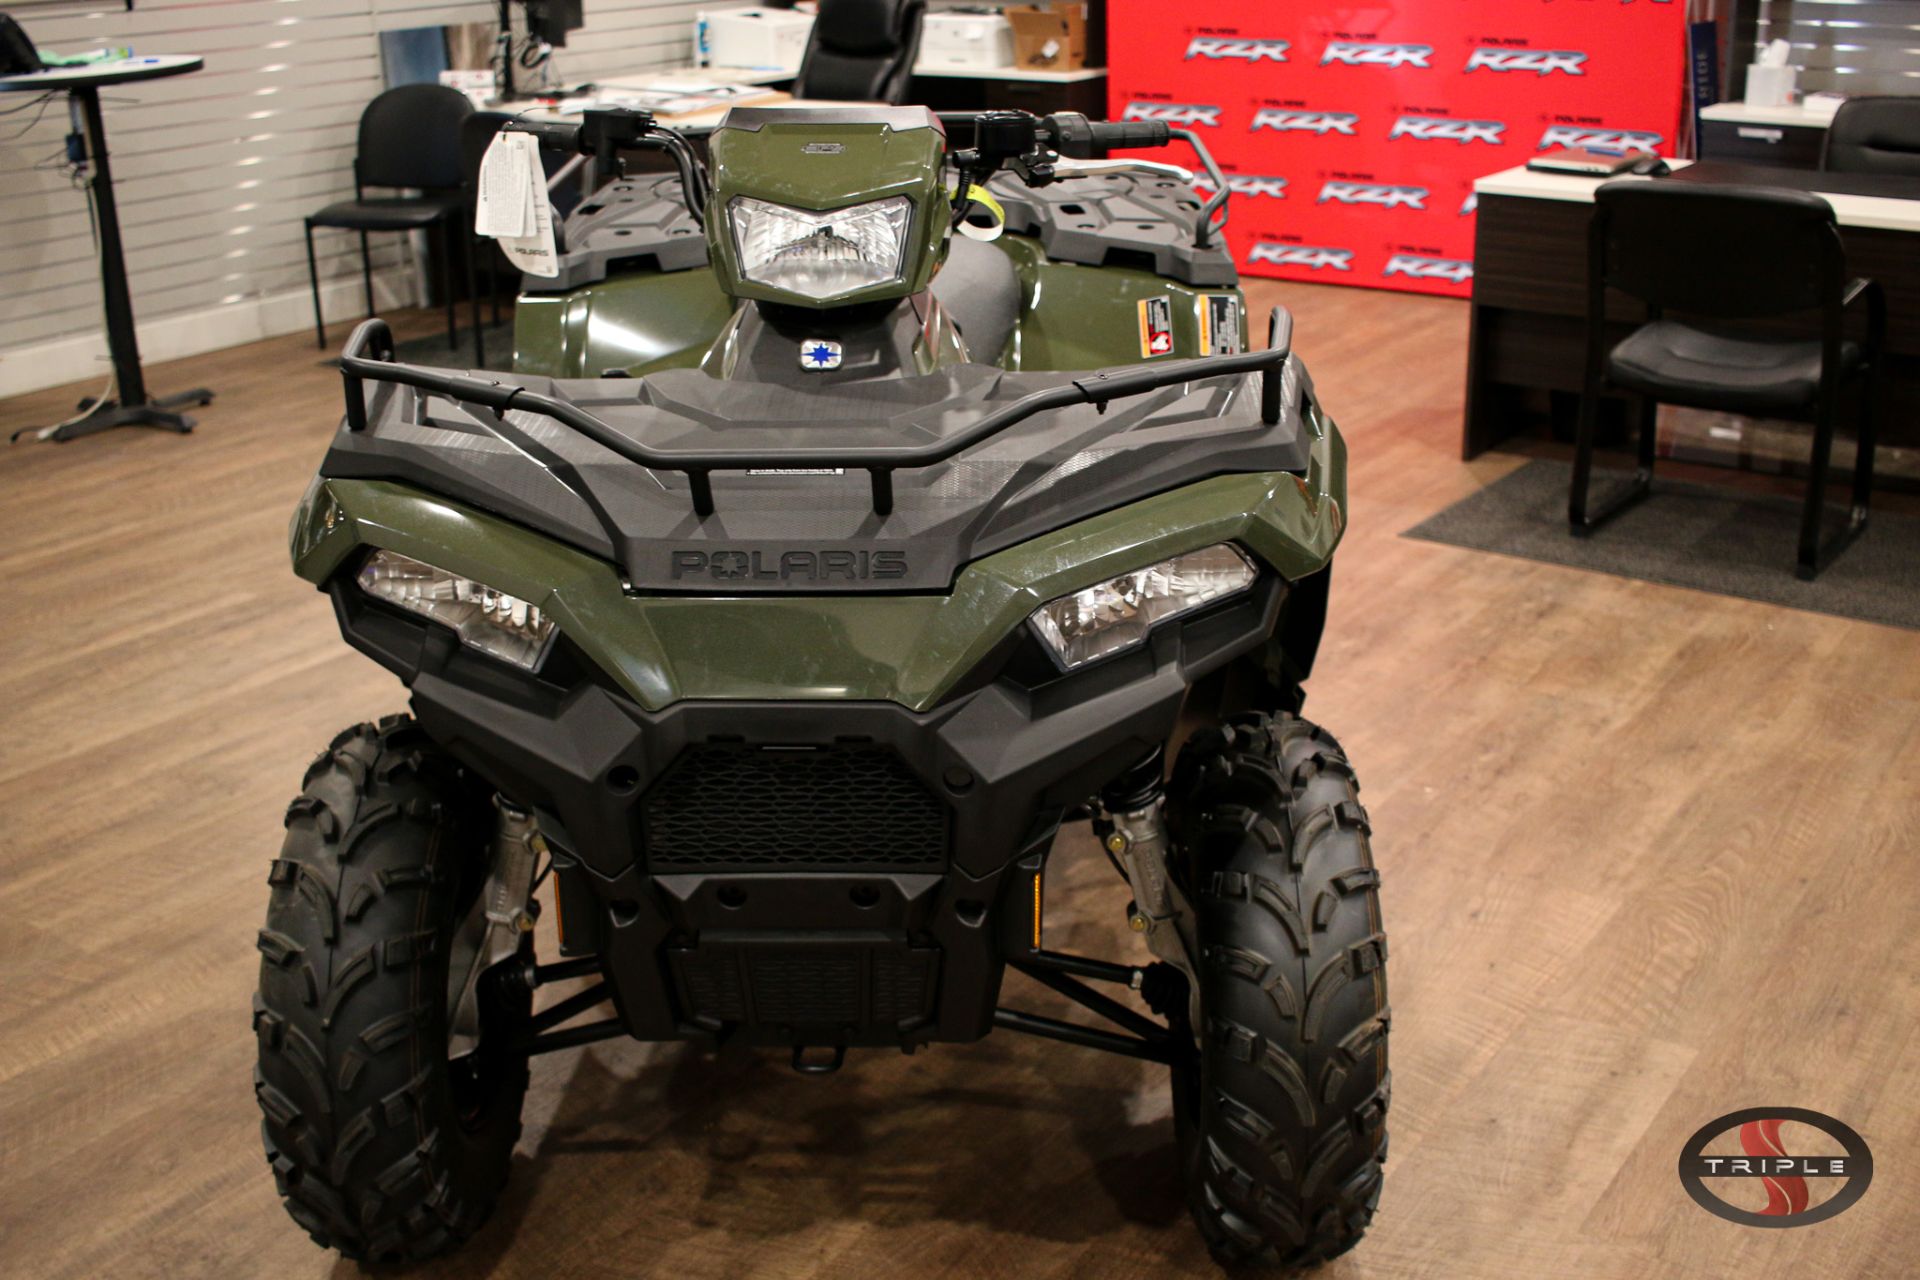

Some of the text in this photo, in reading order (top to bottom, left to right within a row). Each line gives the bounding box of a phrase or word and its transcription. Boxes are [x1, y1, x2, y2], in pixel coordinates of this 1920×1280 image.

[1184, 37, 1291, 62] RZR
[1320, 41, 1435, 68] RZR
[1464, 47, 1589, 76] RZR
[1122, 102, 1222, 127] RZR
[1250, 108, 1360, 135] RZR
[1388, 115, 1506, 144] RZR
[1537, 125, 1665, 157] RZR
[1317, 181, 1430, 210] RZR
[1248, 242, 1355, 271] RZR
[671, 550, 908, 580] POLARIS
